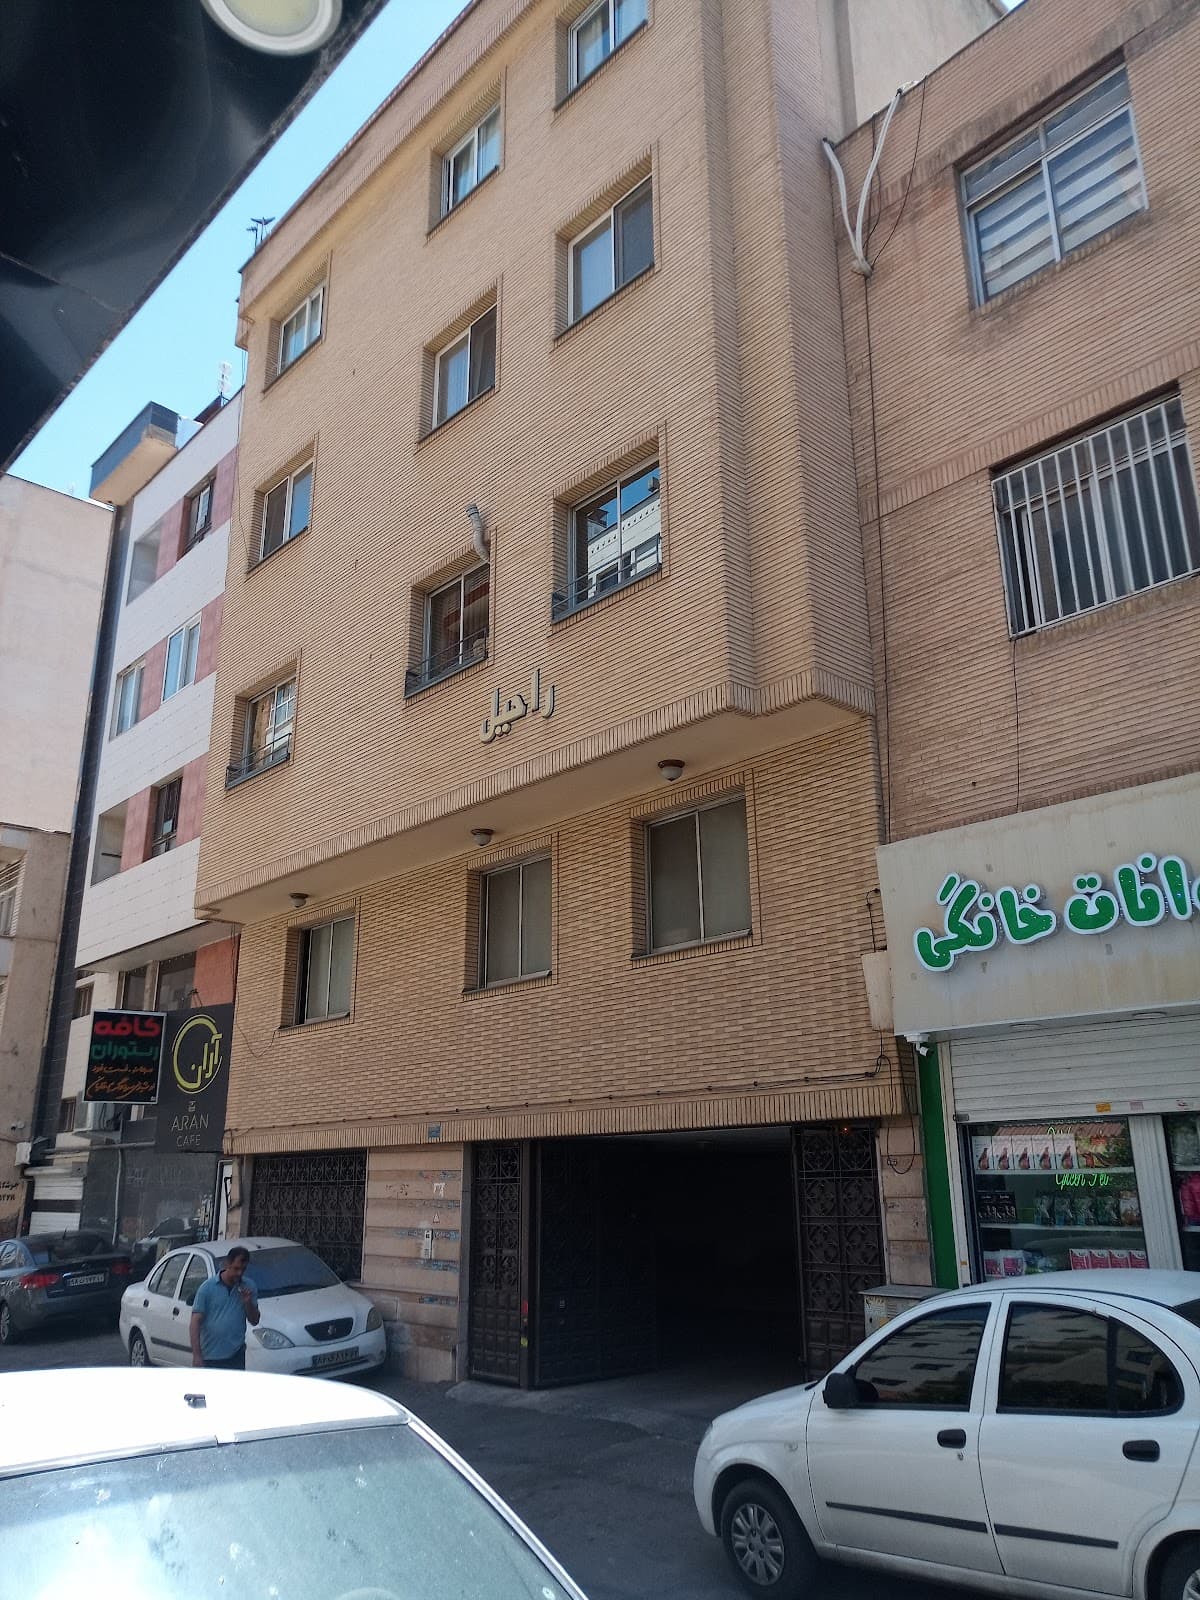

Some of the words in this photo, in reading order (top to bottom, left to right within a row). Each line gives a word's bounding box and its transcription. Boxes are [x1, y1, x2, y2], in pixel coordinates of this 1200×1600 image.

[480, 668, 556, 743] راحیل
[1064, 852, 1200, 935] انات
[913, 872, 1057, 972] خانگی
[94, 1016, 162, 1037] کافه
[91, 1041, 160, 1061] رستوران
[171, 1113, 209, 1132] ARAN
[176, 1134, 201, 1148] CAFE
